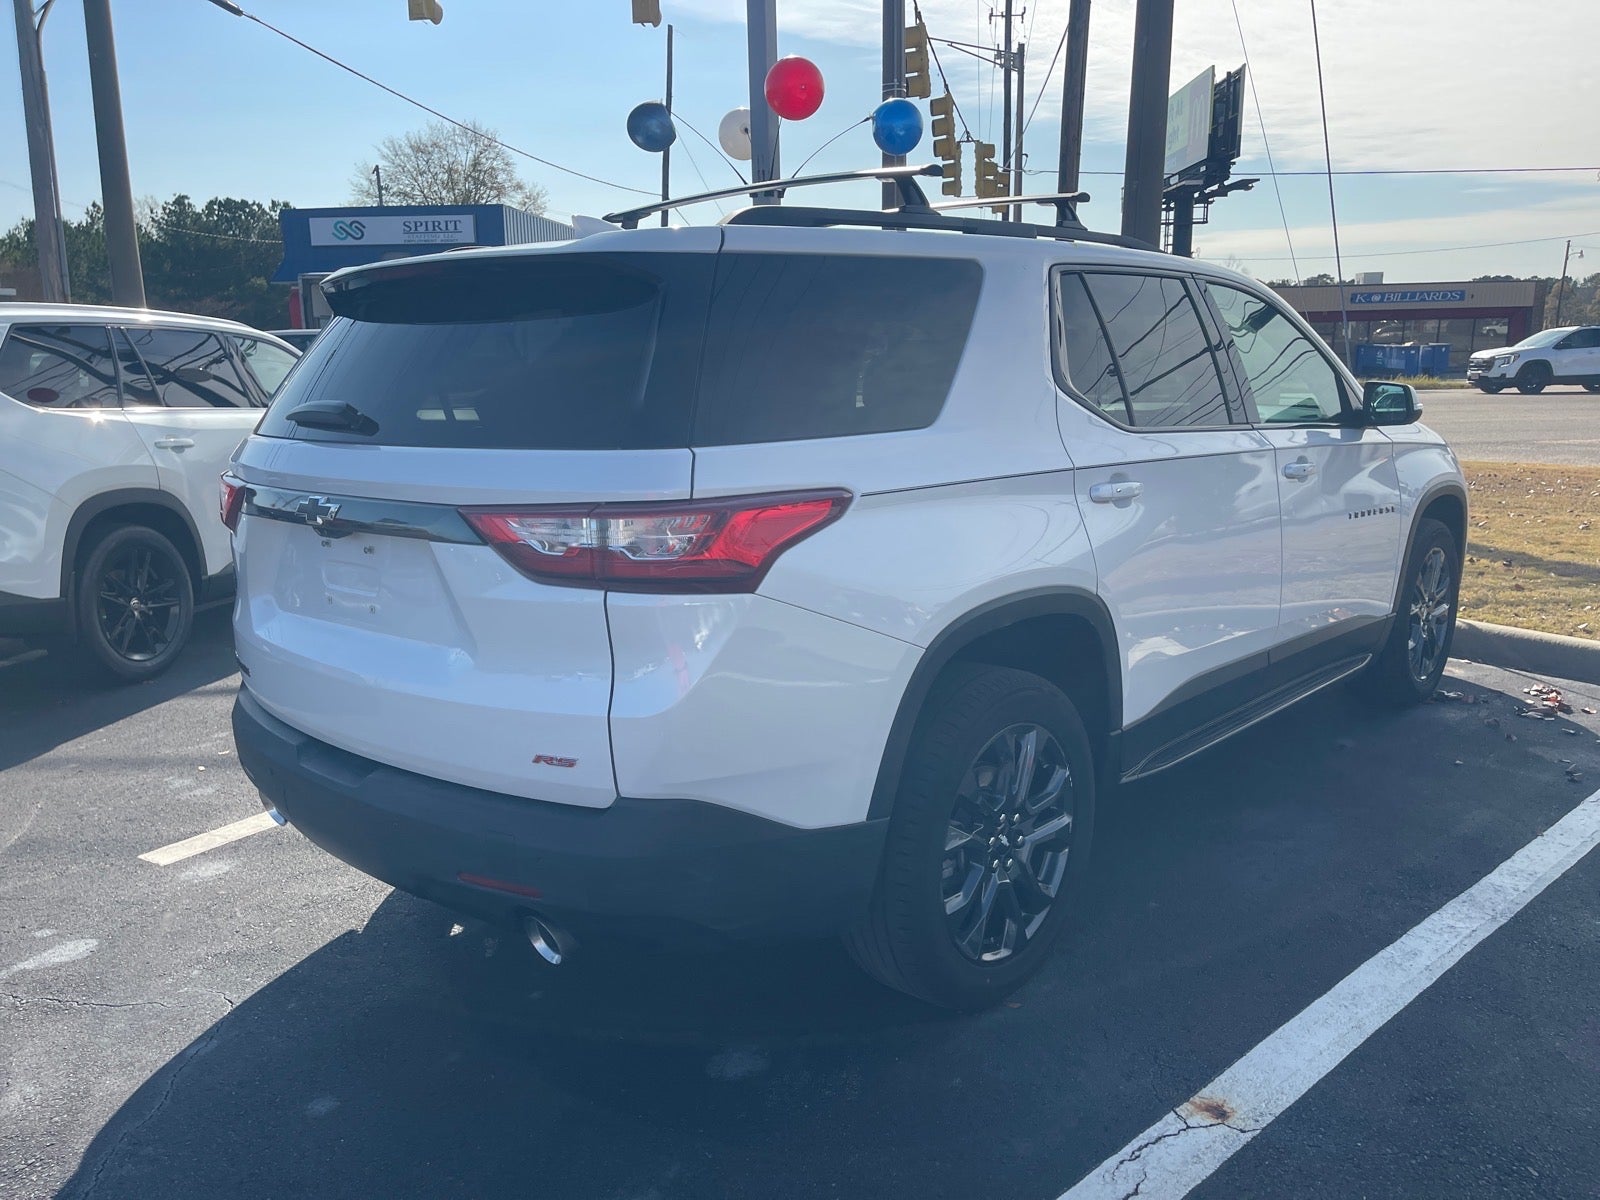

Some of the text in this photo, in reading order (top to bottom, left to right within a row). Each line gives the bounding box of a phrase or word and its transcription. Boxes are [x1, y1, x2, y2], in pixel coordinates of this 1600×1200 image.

[402, 219, 462, 232] SPIRIT
[1383, 291, 1461, 302] BILLIARDS
[532, 754, 579, 768] RS
